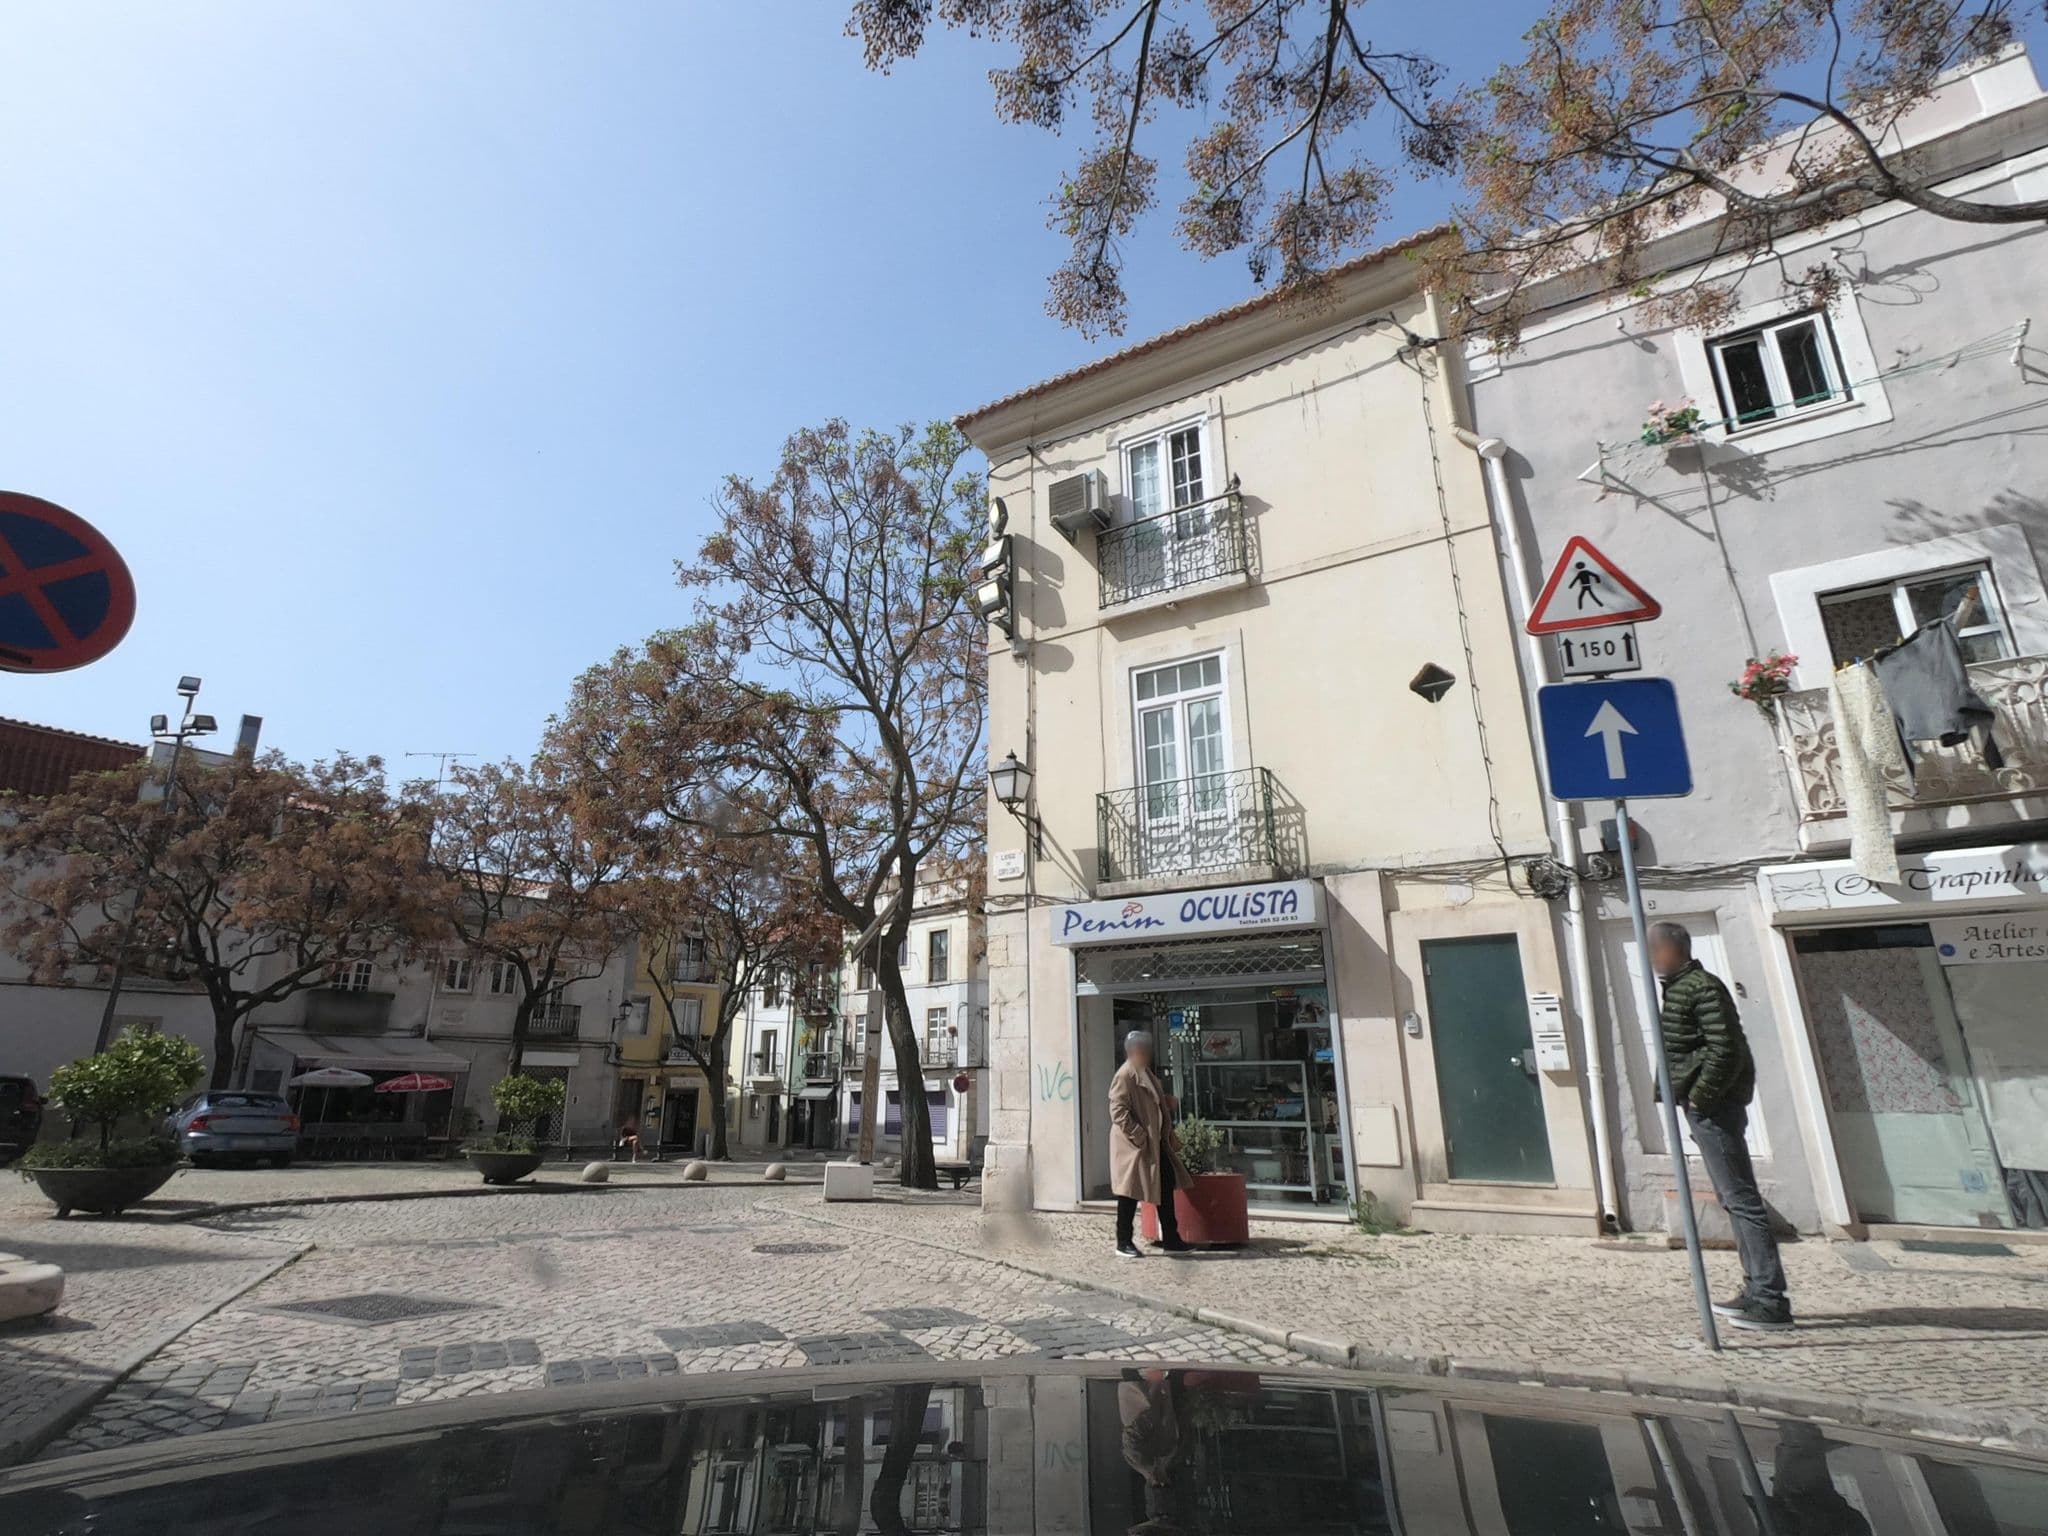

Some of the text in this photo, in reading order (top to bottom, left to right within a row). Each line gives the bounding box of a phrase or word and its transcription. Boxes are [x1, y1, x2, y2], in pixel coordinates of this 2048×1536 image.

[1580, 640, 1615, 658] 150
[1063, 909, 1165, 936] Penim
[1963, 922, 2038, 941] Atelier
[1969, 948, 1979, 959] e
